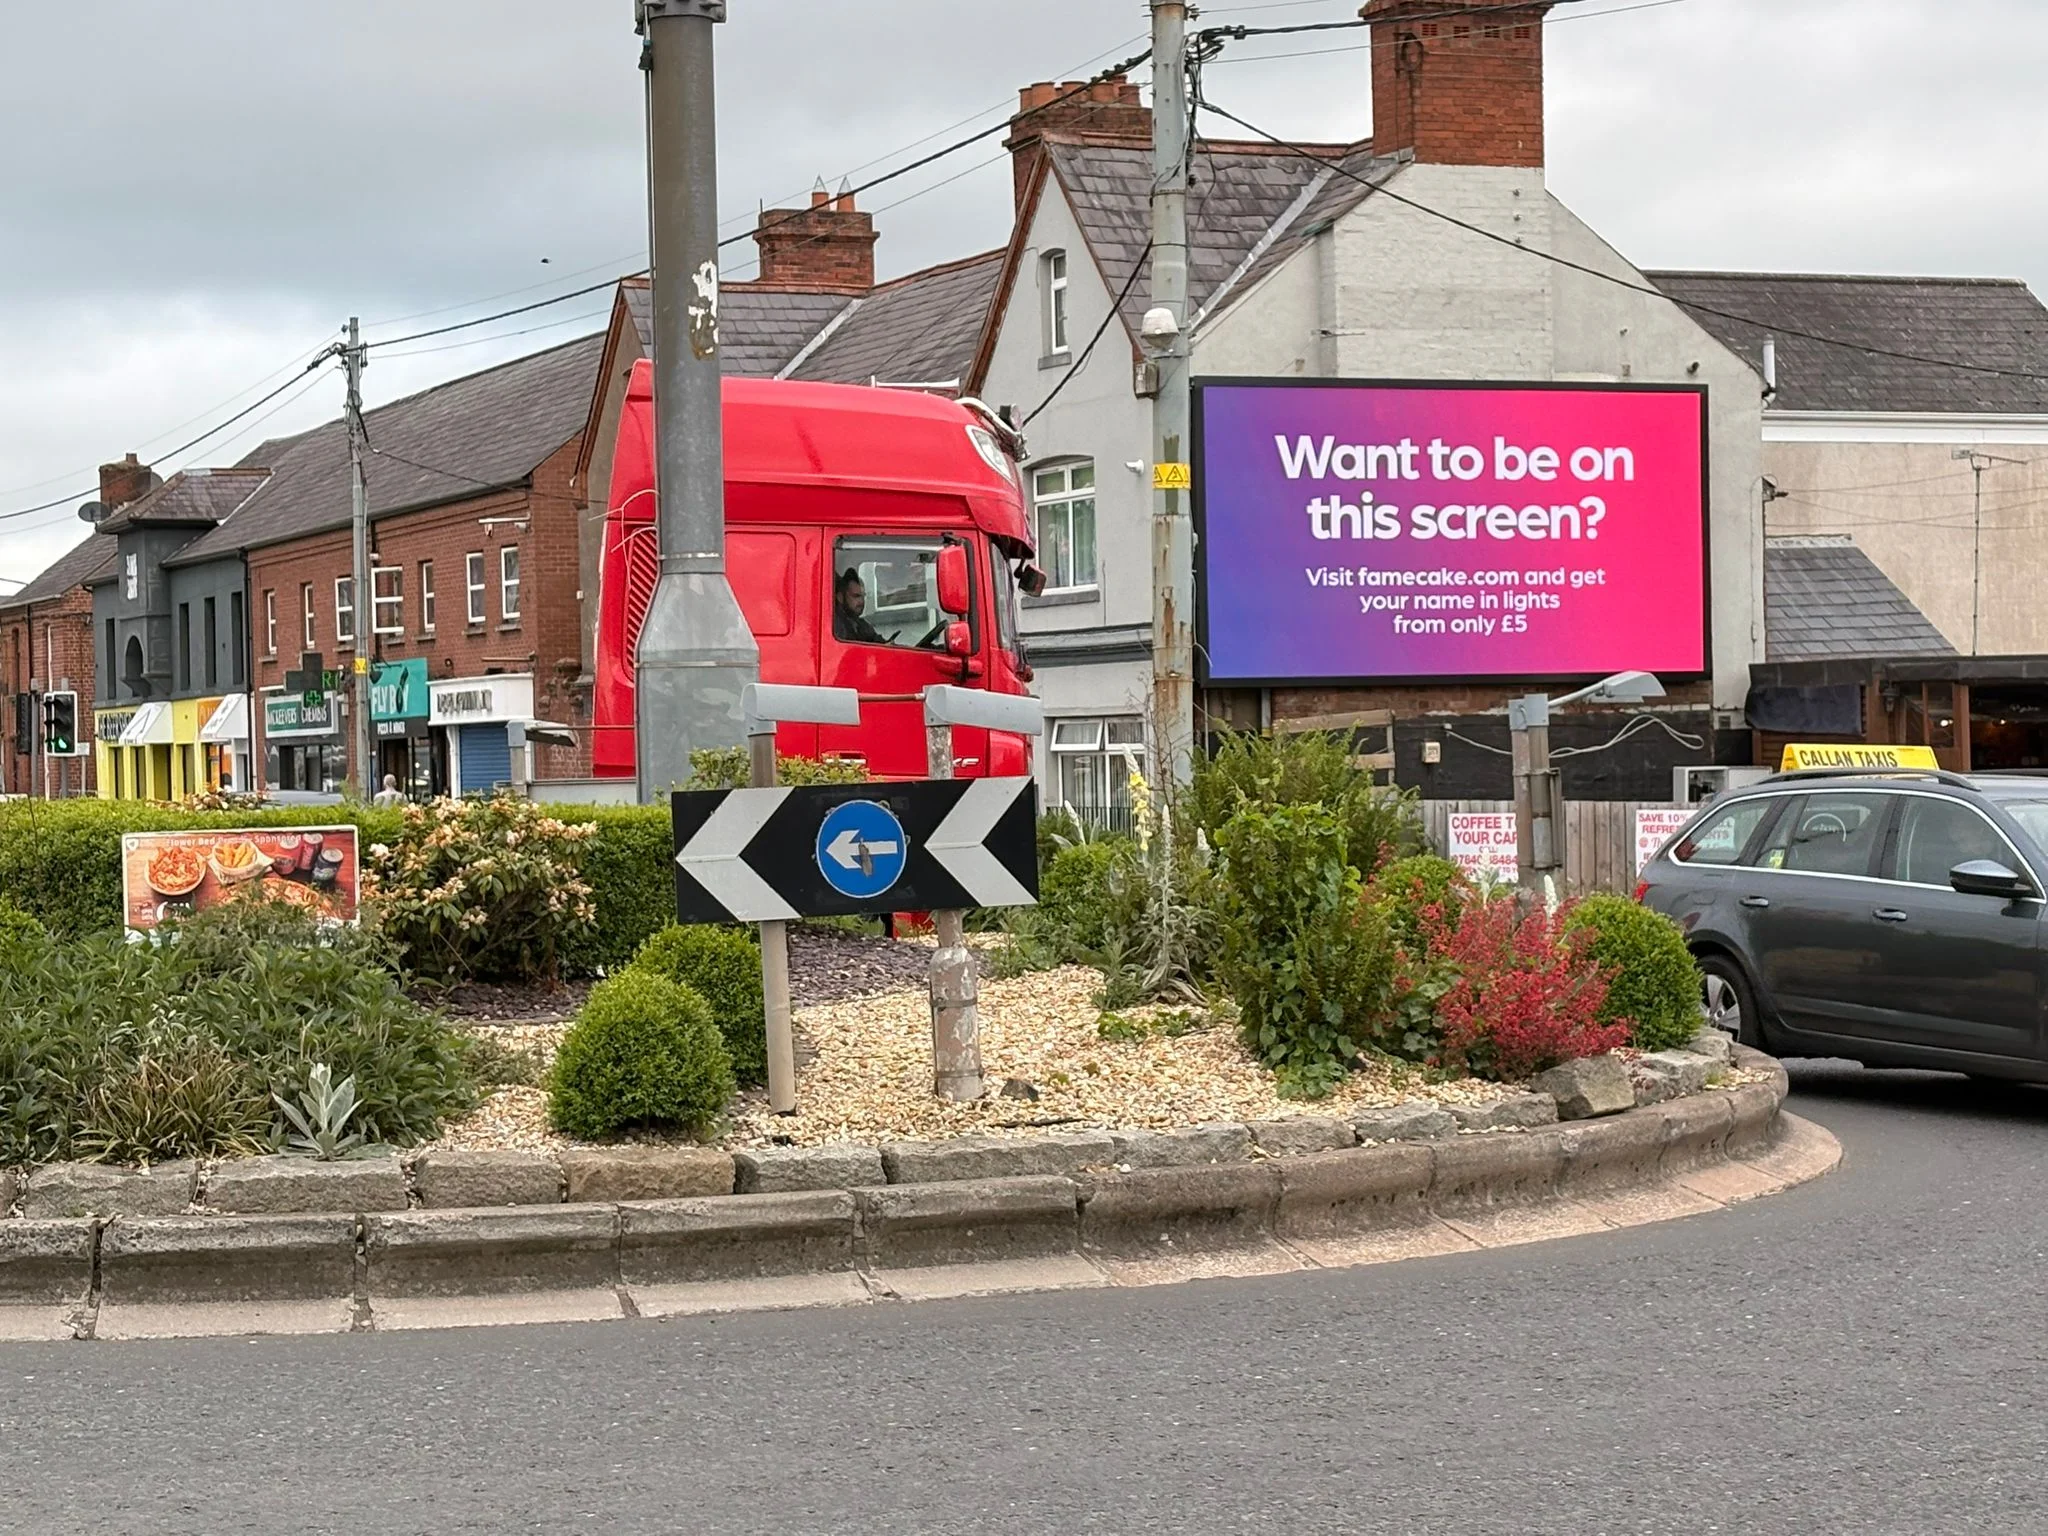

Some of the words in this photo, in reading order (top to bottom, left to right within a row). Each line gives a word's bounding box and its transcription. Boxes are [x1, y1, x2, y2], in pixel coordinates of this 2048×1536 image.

[1275, 434, 1420, 480] Want
[1428, 438, 1484, 481] to
[1494, 436, 1560, 481] be
[1570, 446, 1634, 481] on
[1306, 491, 1402, 540] this
[1410, 495, 1606, 540] screen?
[1305, 566, 1354, 587] Visit
[1358, 566, 1520, 586] famecake.com
[1525, 567, 1565, 585] and
[1570, 568, 1606, 588] get
[1360, 594, 1410, 613] your
[1414, 594, 1475, 610] name
[1481, 591, 1499, 609] in
[1503, 591, 1561, 613] lights
[1393, 614, 1446, 634] from
[1450, 614, 1496, 637] only
[1501, 614, 1528, 633] £5
[1799, 750, 1853, 767] CALLAN
[1855, 751, 1898, 768] TAXIS
[1452, 816, 1502, 829] COFFEE
[1639, 813, 1664, 822] SAVE
[198, 837, 215, 845] Bed
[1454, 831, 1490, 845] YOUR
